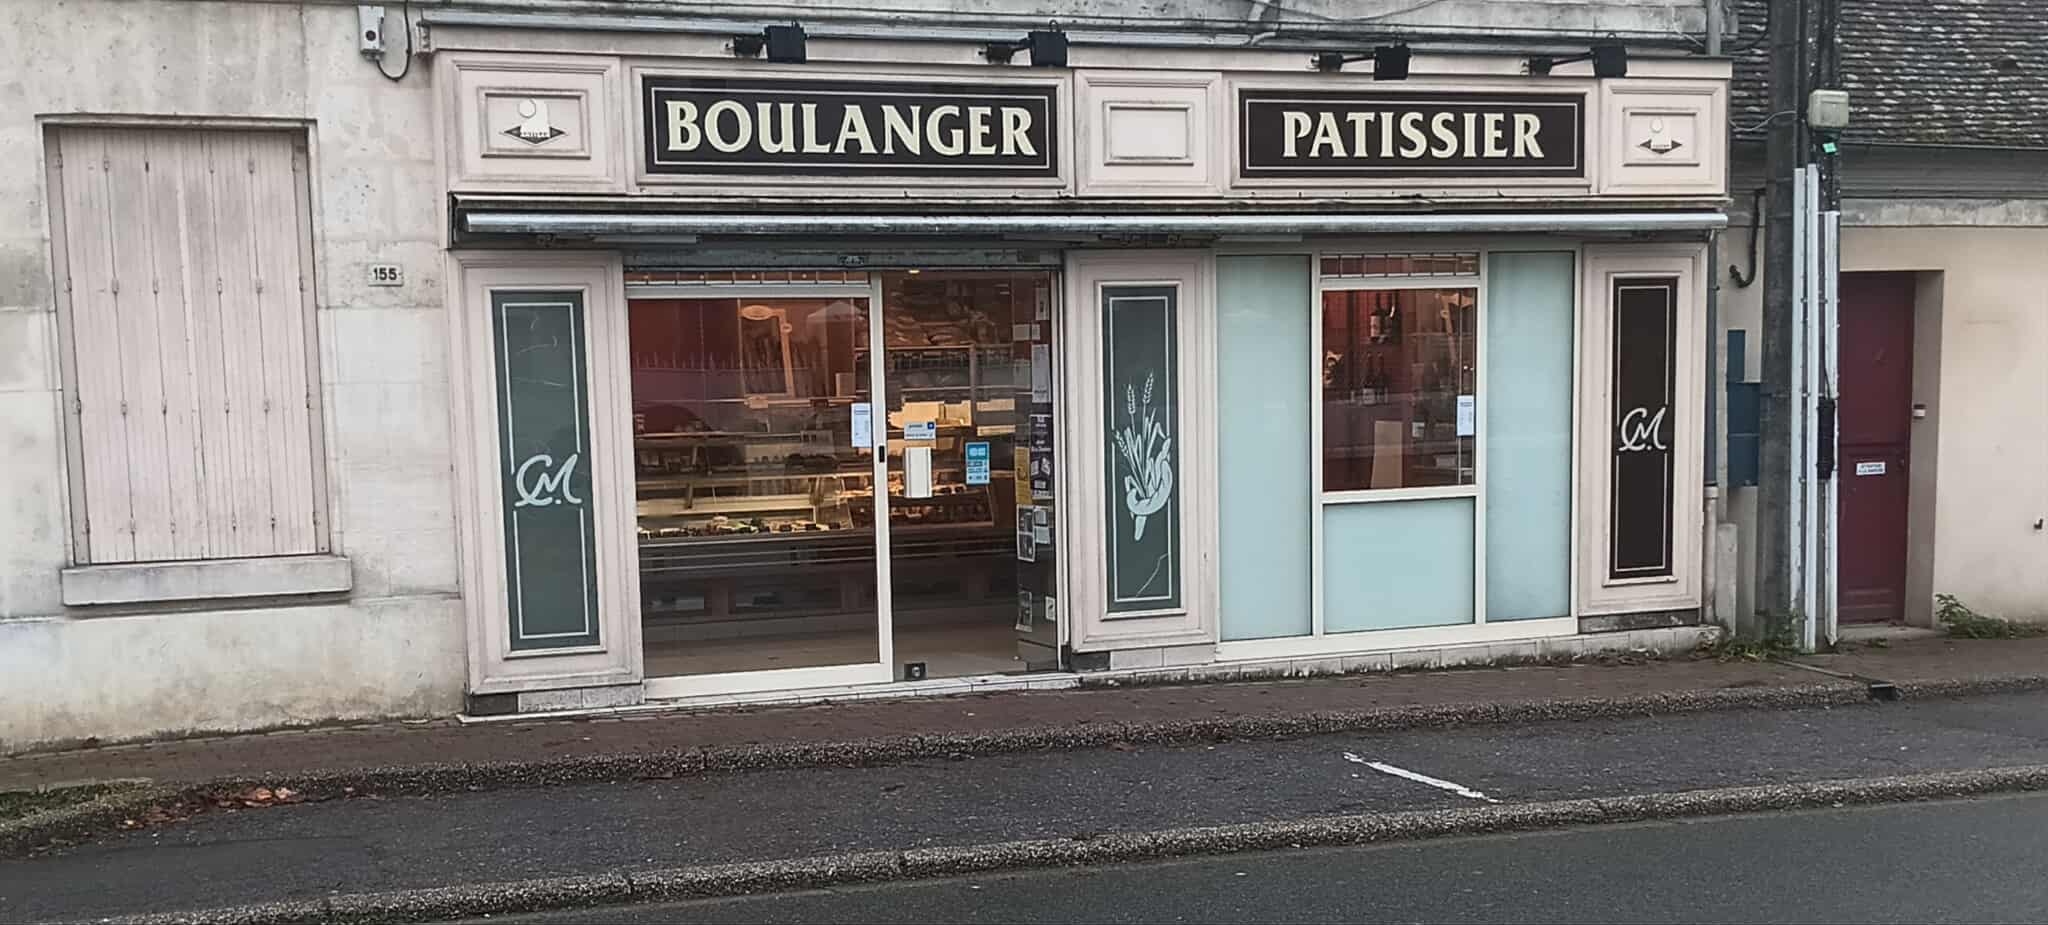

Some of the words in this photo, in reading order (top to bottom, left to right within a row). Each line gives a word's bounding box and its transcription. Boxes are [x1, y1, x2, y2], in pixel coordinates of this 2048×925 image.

[665, 100, 1038, 156] BOULANGER
[1282, 111, 1545, 158] PATISSIER
[373, 267, 397, 281] 155
